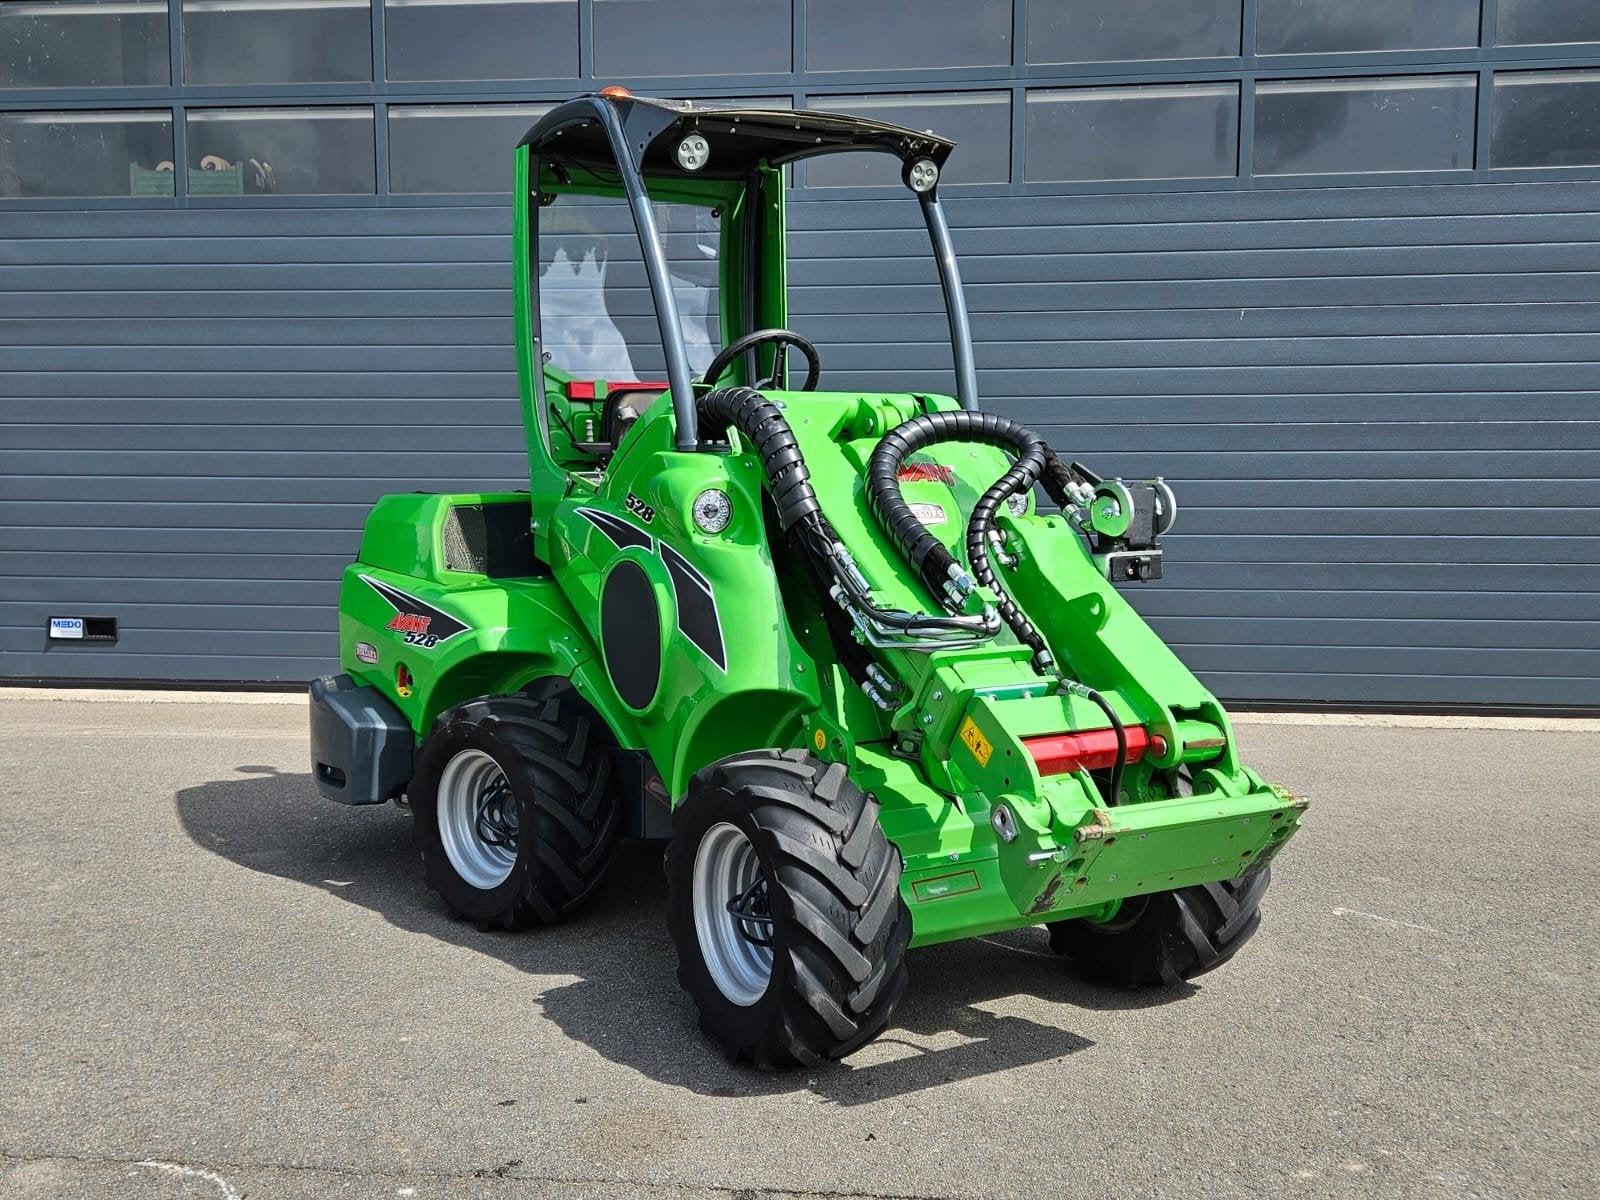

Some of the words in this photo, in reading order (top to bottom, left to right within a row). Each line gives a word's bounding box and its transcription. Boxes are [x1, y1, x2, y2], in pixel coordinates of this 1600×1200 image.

[625, 492, 655, 524] 528
[52, 620, 82, 629] MEDO
[384, 611, 432, 634] AVANT
[403, 630, 439, 648] 528
